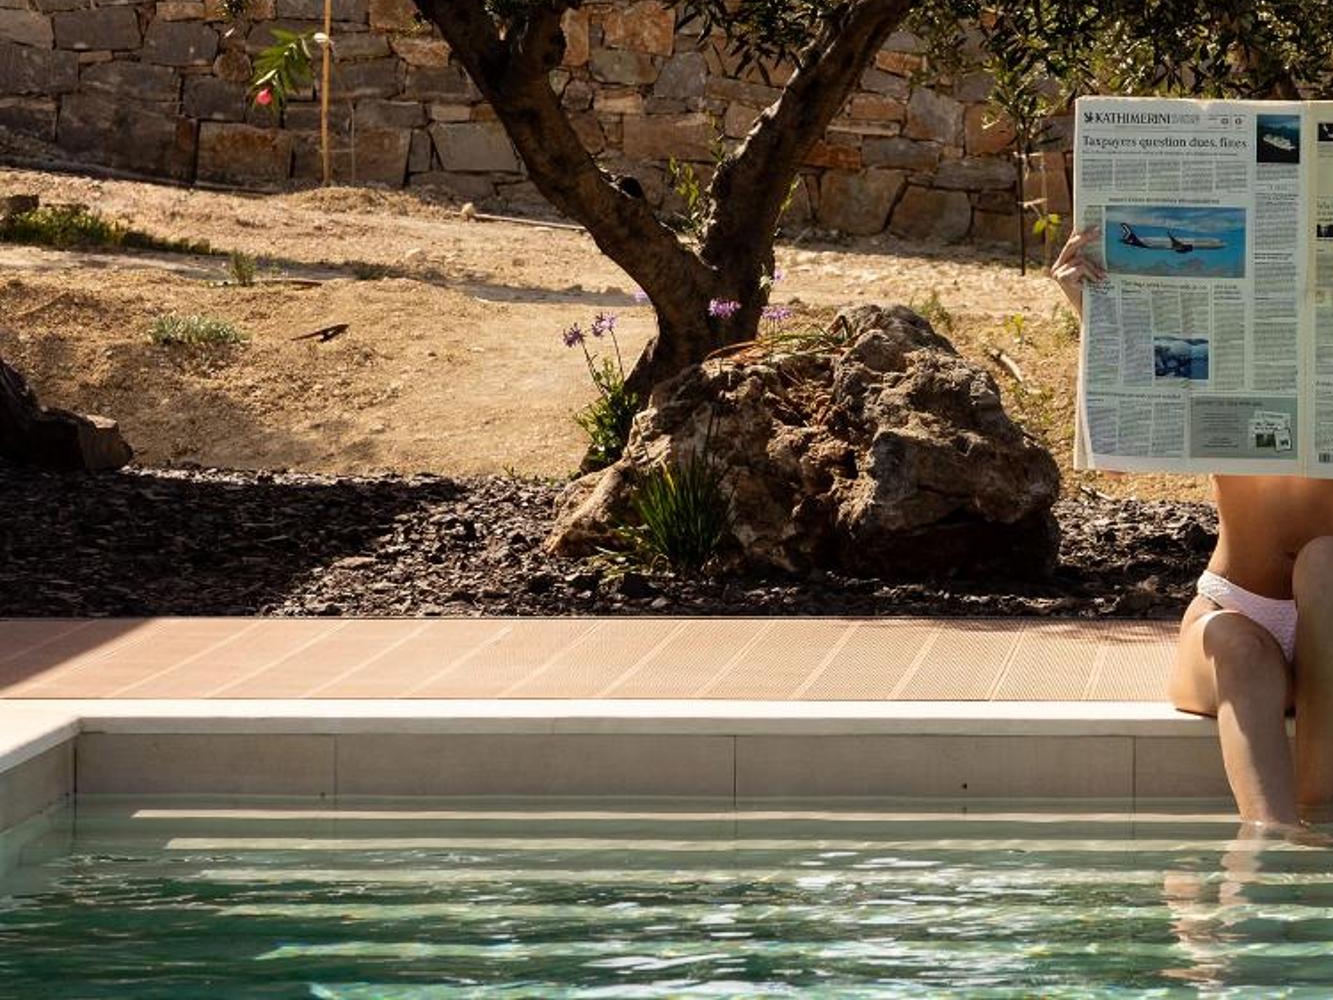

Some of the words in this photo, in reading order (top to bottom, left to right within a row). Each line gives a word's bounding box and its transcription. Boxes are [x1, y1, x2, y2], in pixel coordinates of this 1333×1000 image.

[1095, 112, 1170, 124] KATHIMERINI
[1083, 135, 1136, 149] Taxpayers
[1139, 136, 1187, 149] question
